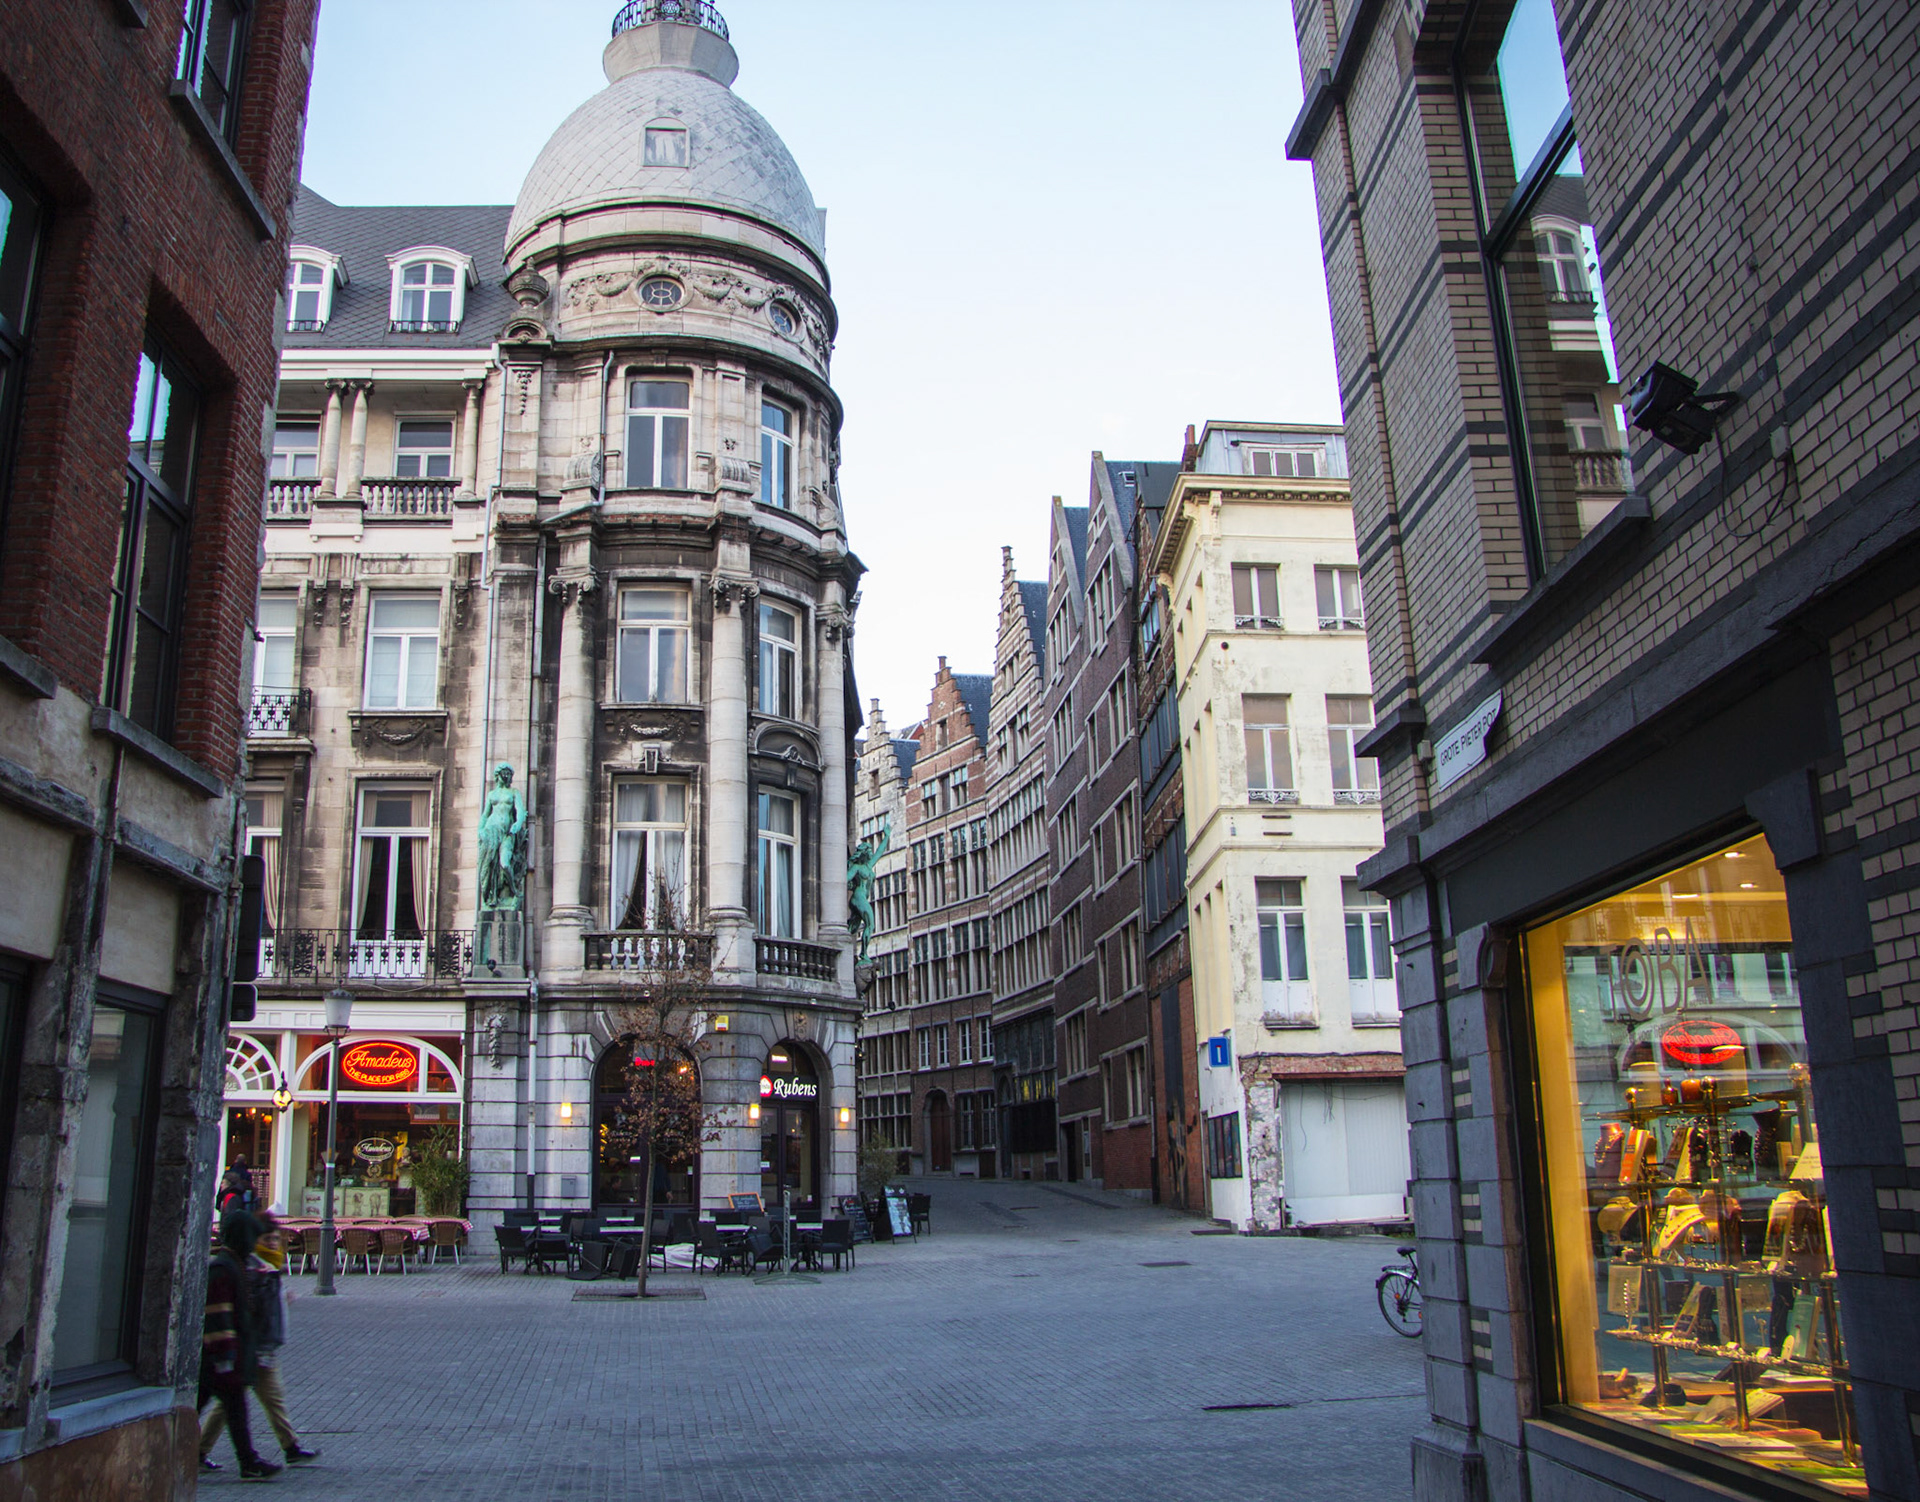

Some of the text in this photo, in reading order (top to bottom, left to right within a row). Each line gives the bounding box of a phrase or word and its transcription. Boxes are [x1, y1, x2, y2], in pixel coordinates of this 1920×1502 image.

[1441, 740, 1460, 766] GROTE
[1461, 721, 1482, 750] PIETER
[1601, 917, 1713, 1024] TOBA
[346, 1050, 413, 1068] Amadeus
[348, 1067, 362, 1077] THE
[361, 1073, 381, 1082] PLACE
[381, 1074, 396, 1083] FOR
[773, 1077, 817, 1098] Rubens
